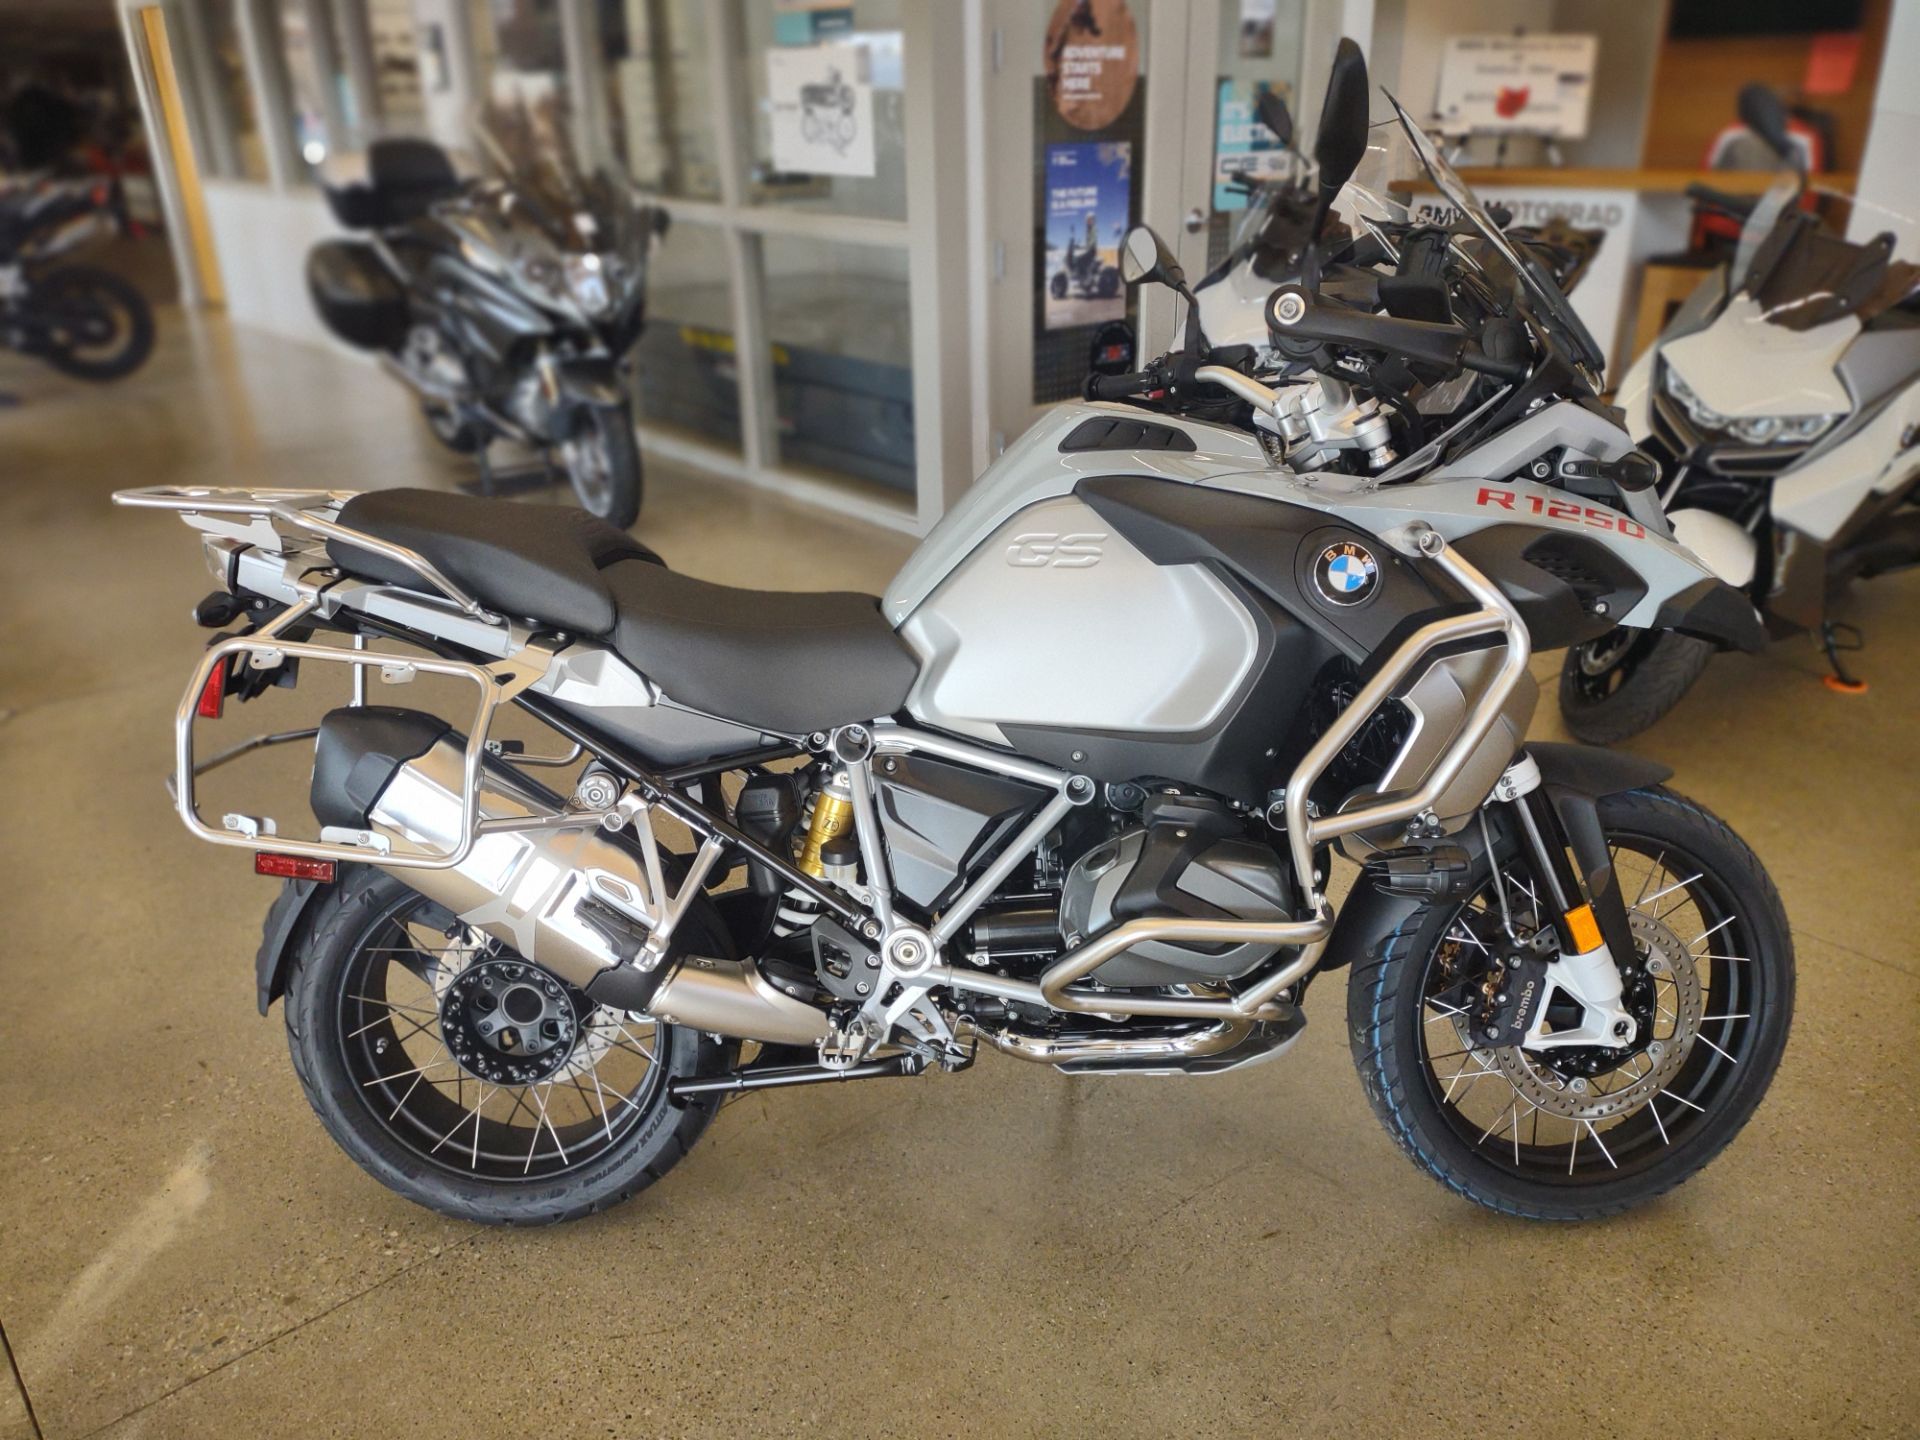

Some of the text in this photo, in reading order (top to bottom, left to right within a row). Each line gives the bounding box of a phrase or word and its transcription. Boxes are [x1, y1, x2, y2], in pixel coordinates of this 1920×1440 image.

[1484, 201, 1623, 227] OTORRAD
[1006, 533, 1108, 568] GS
[1324, 545, 1373, 568] BMW
[1511, 980, 1535, 1030] brembo
